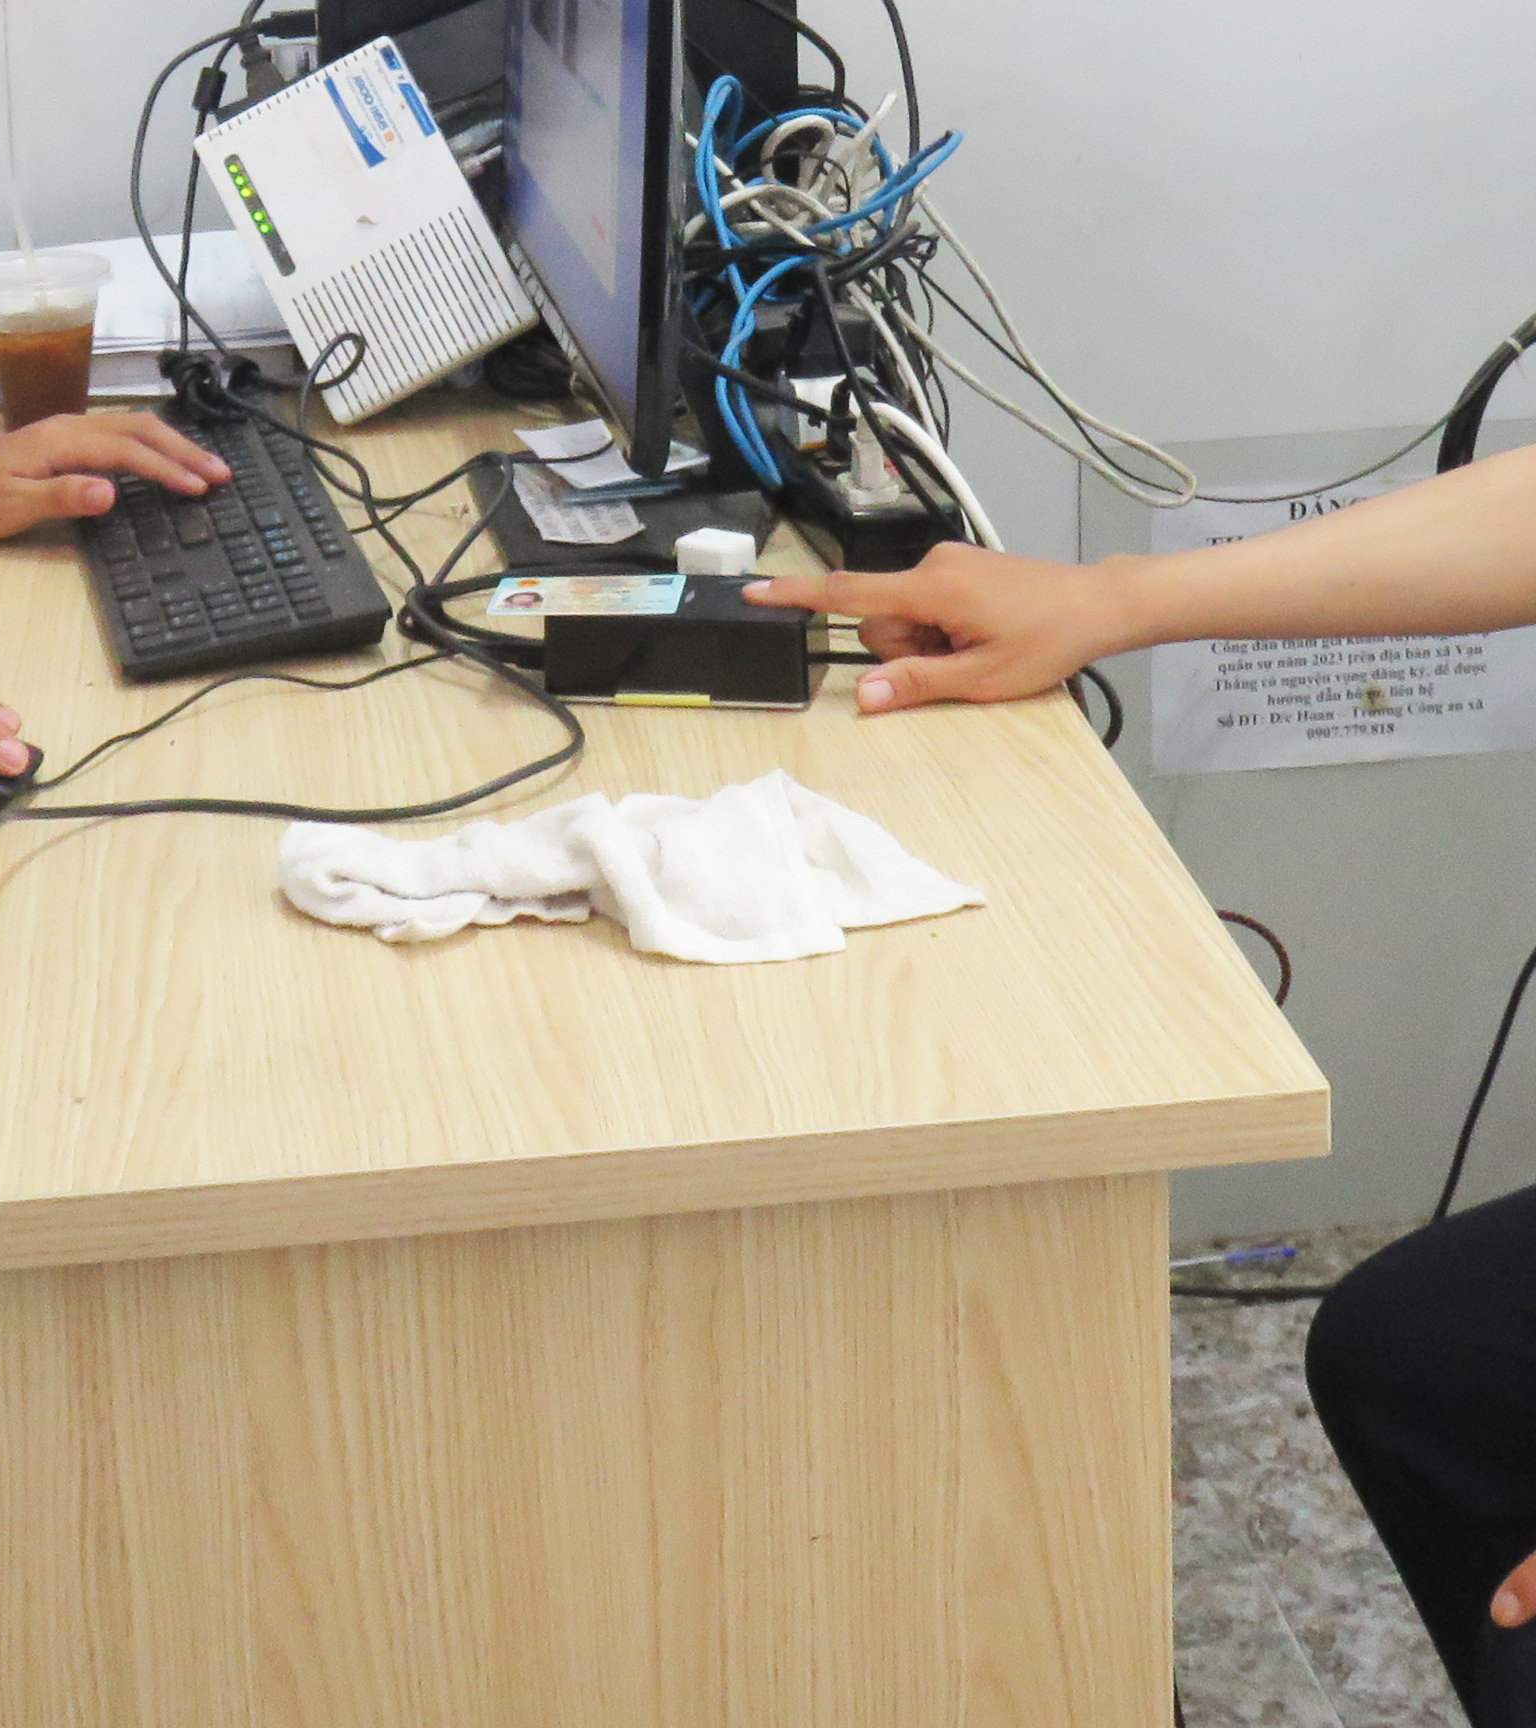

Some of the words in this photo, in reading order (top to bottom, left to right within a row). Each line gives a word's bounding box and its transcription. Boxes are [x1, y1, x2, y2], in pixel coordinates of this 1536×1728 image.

[1218, 657, 1254, 675] quân
[1311, 652, 1344, 668] 2023
[1447, 700, 1464, 712] an
